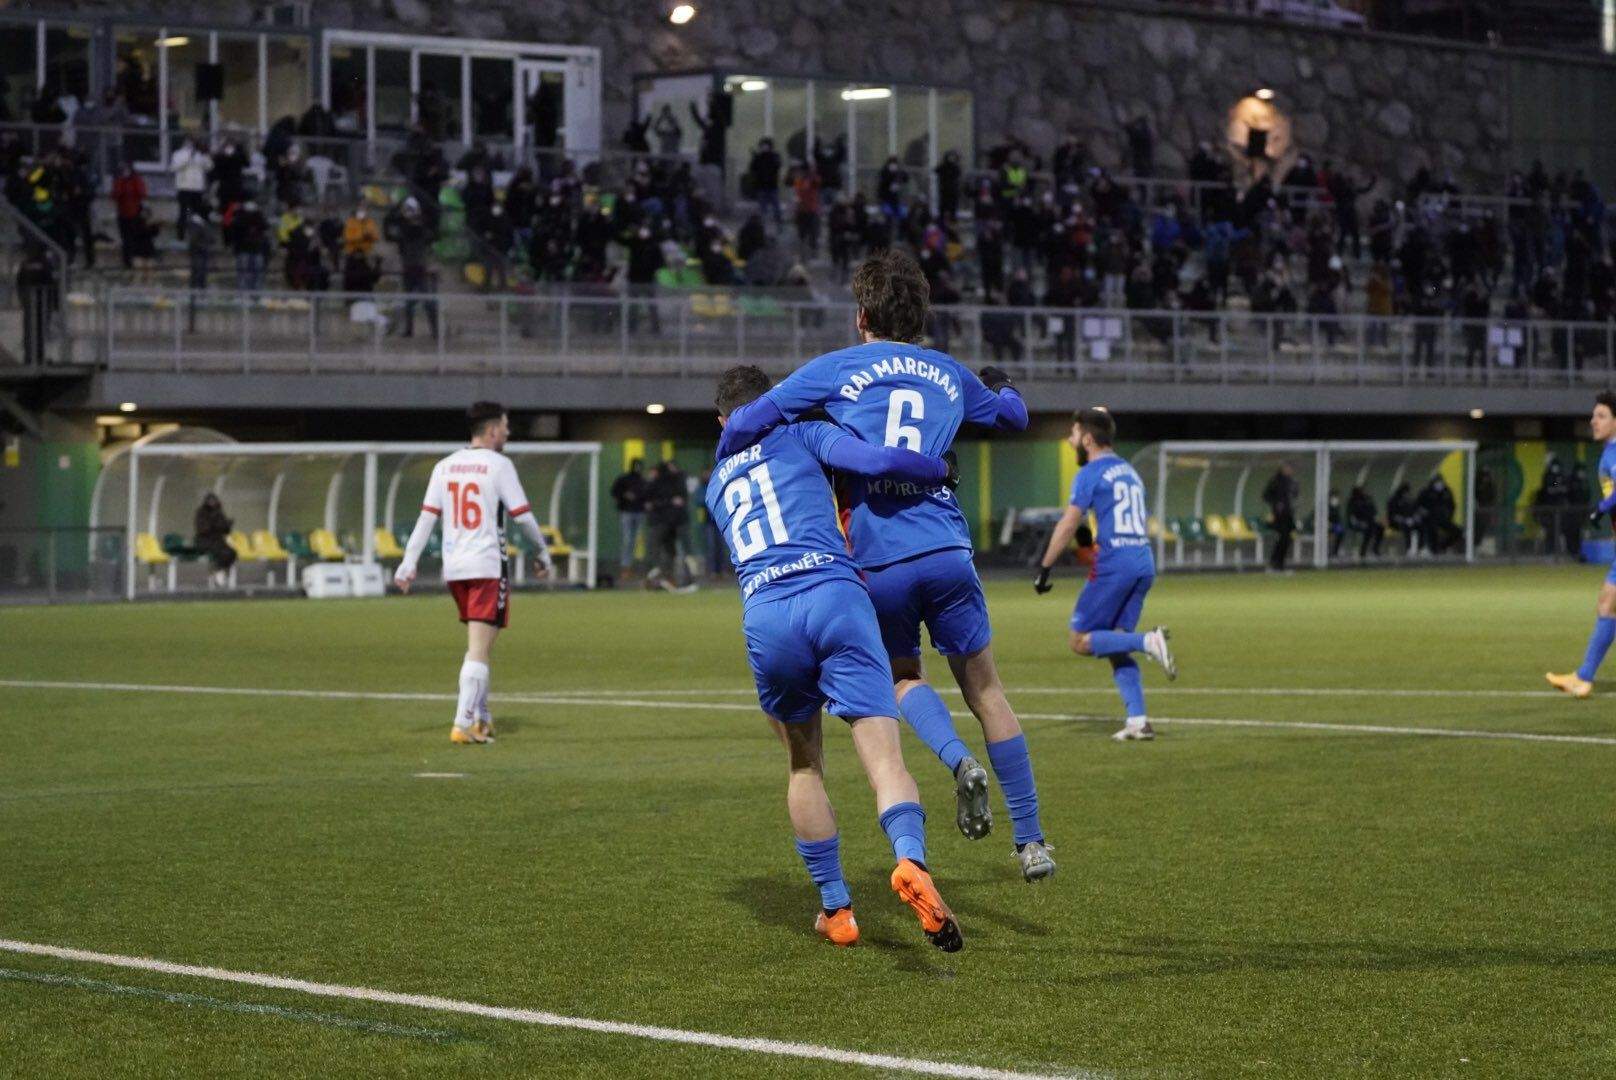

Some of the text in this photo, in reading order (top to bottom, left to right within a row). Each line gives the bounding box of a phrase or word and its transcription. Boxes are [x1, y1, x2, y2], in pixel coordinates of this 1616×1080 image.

[840, 356, 959, 402] RAI MARCHAN
[884, 389, 924, 453] 6
[719, 443, 762, 484] BOVER
[447, 482, 482, 530] 16
[723, 461, 790, 563] 21
[1113, 480, 1146, 536] 20
